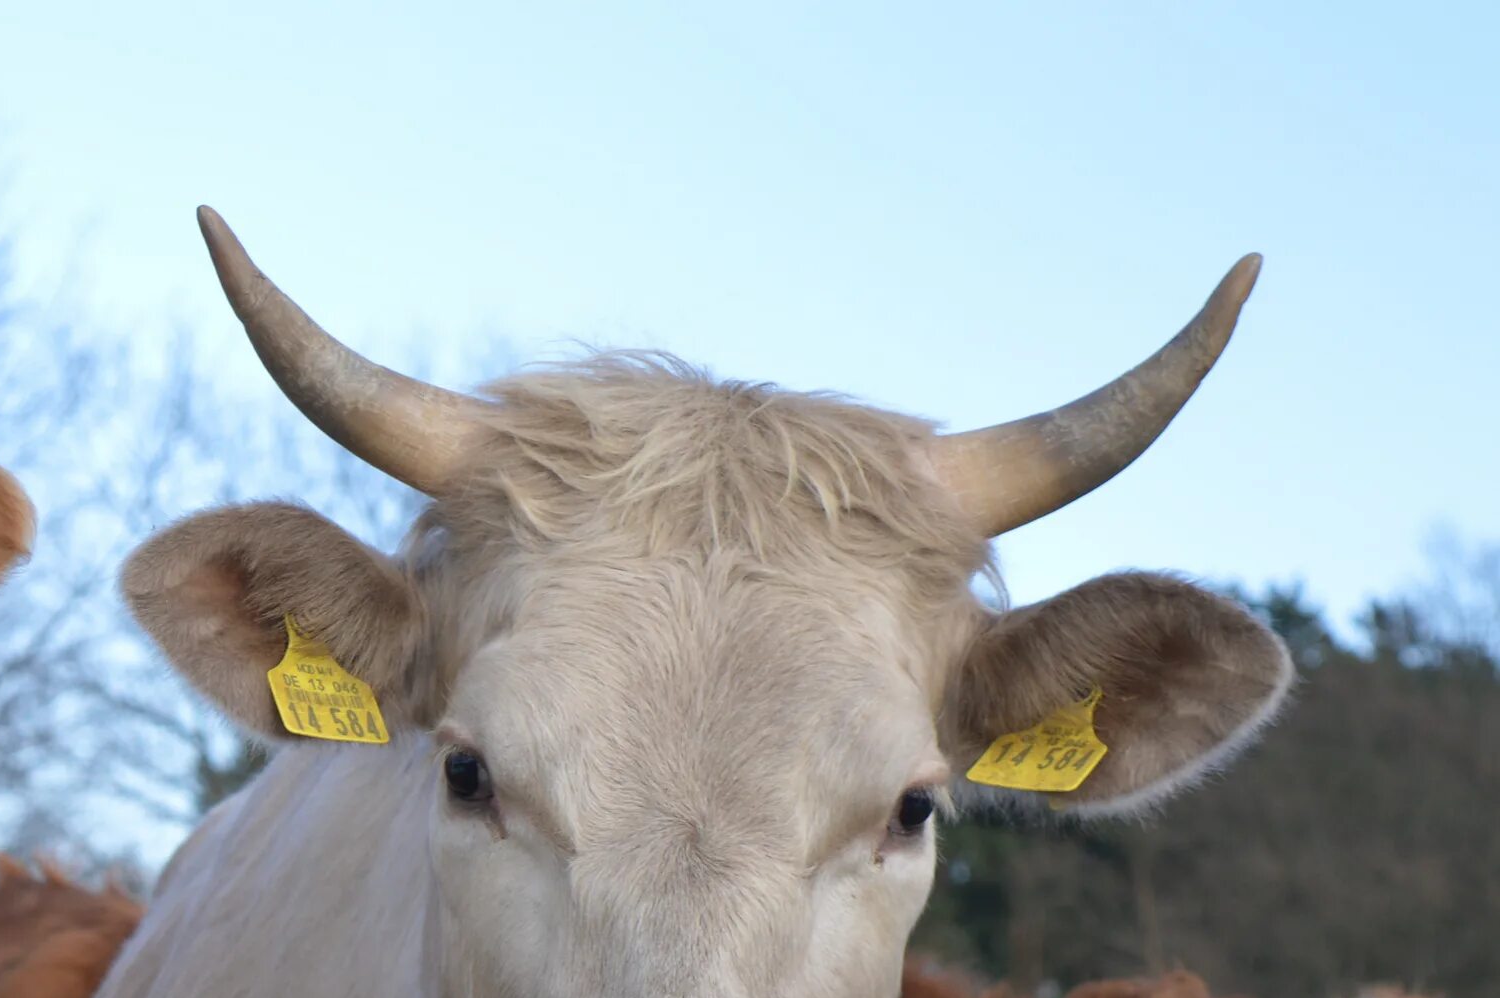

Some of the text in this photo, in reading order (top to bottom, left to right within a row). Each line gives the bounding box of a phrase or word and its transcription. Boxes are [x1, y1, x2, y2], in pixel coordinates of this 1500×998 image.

[282, 673, 359, 695] DE 13 046
[288, 702, 381, 739] 14 584
[993, 741, 1032, 767] 14
[1038, 747, 1095, 772] 584
